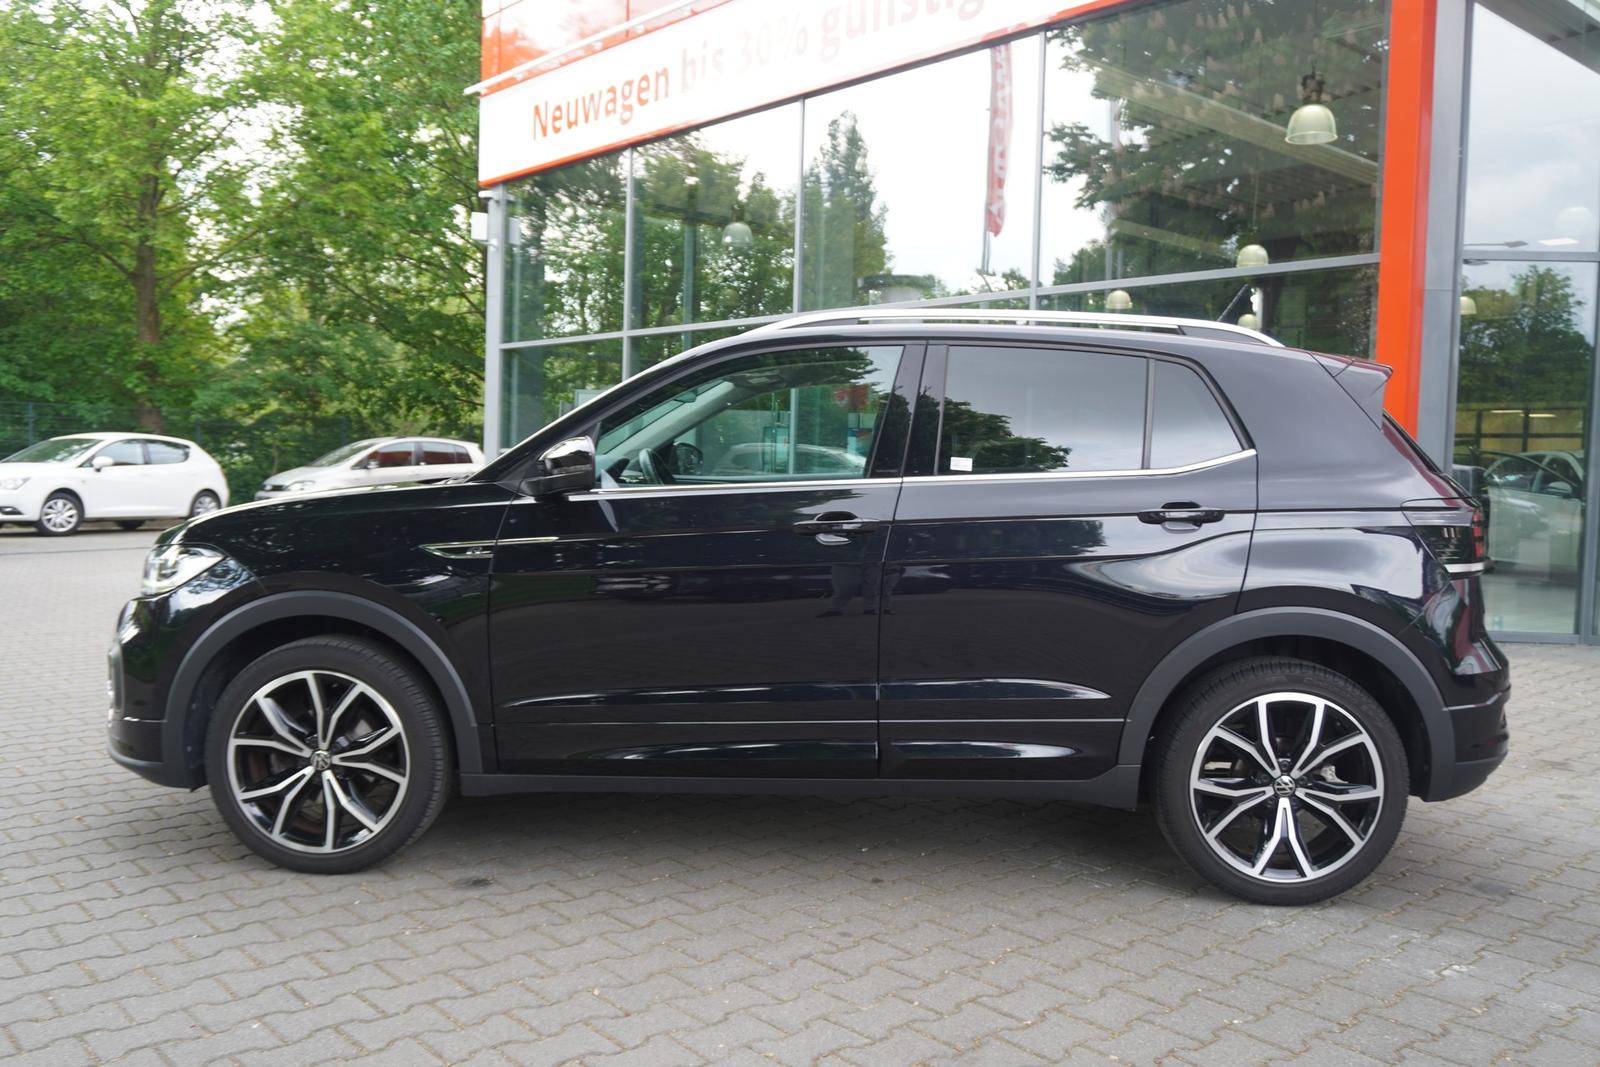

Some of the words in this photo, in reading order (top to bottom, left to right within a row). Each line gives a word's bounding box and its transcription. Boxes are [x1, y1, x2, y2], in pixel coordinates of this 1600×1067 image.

[533, 67, 669, 140] Neuwagen
[680, 40, 725, 94] bis
[736, 10, 808, 76] 30%
